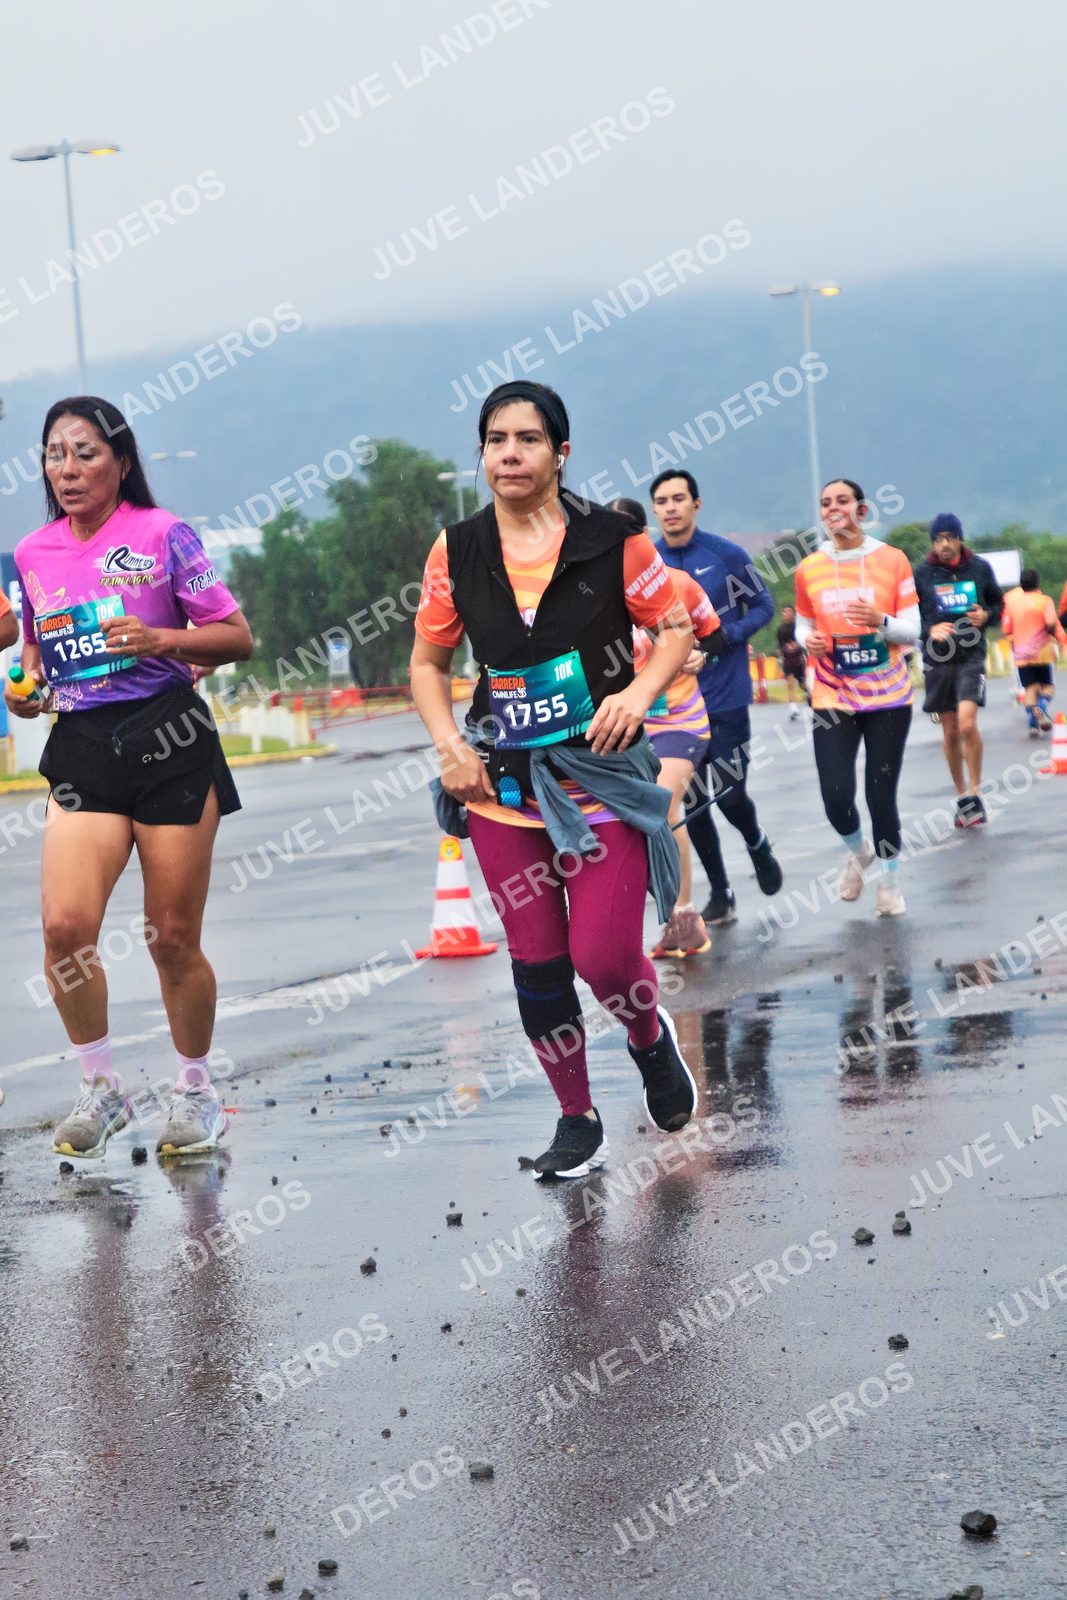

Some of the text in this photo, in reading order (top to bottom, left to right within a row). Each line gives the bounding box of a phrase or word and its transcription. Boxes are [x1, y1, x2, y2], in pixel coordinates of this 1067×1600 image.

[96, 603, 115, 622] 10K
[40, 614, 73, 632] CARRERA
[53, 632, 107, 662] 1265
[842, 649, 879, 664] 1652
[554, 660, 574, 682] 10K
[490, 676, 526, 690] CARRERA
[505, 693, 568, 727] 1755
